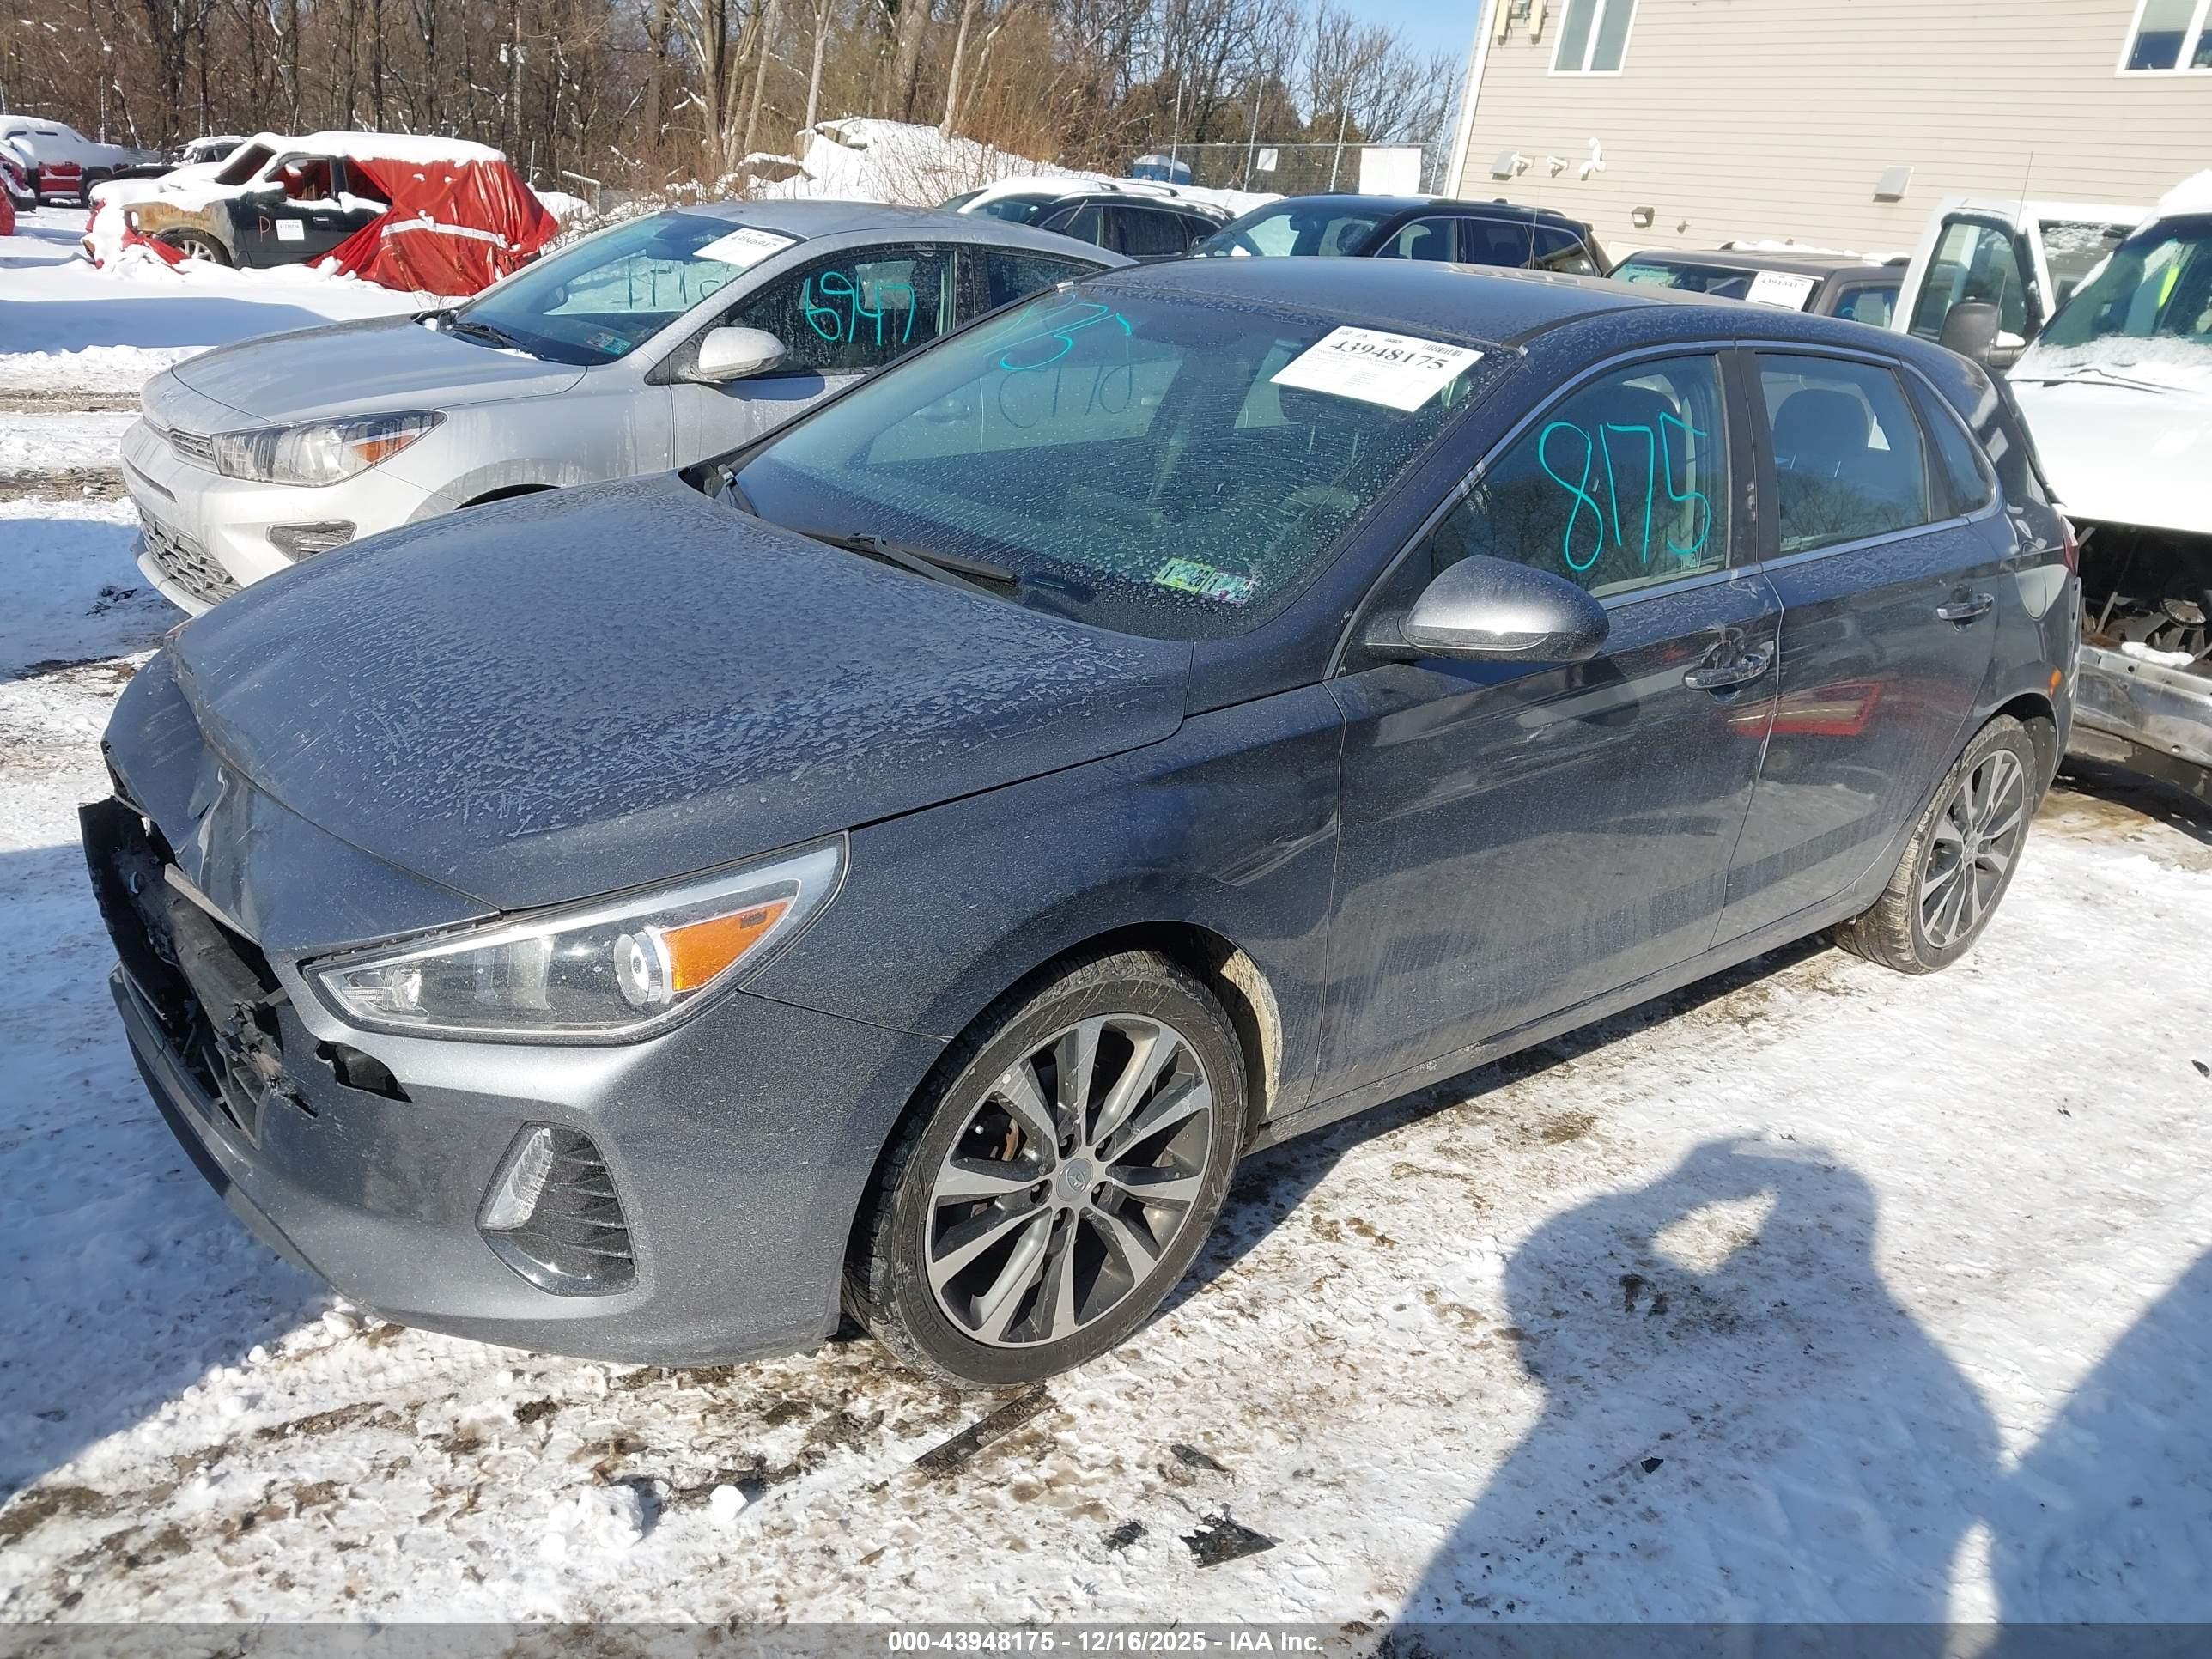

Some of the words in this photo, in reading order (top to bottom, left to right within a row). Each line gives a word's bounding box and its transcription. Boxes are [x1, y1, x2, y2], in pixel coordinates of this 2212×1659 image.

[804, 271, 915, 346] 6947
[1329, 341, 1449, 370] 43948175
[1539, 412, 1711, 571] 8175
